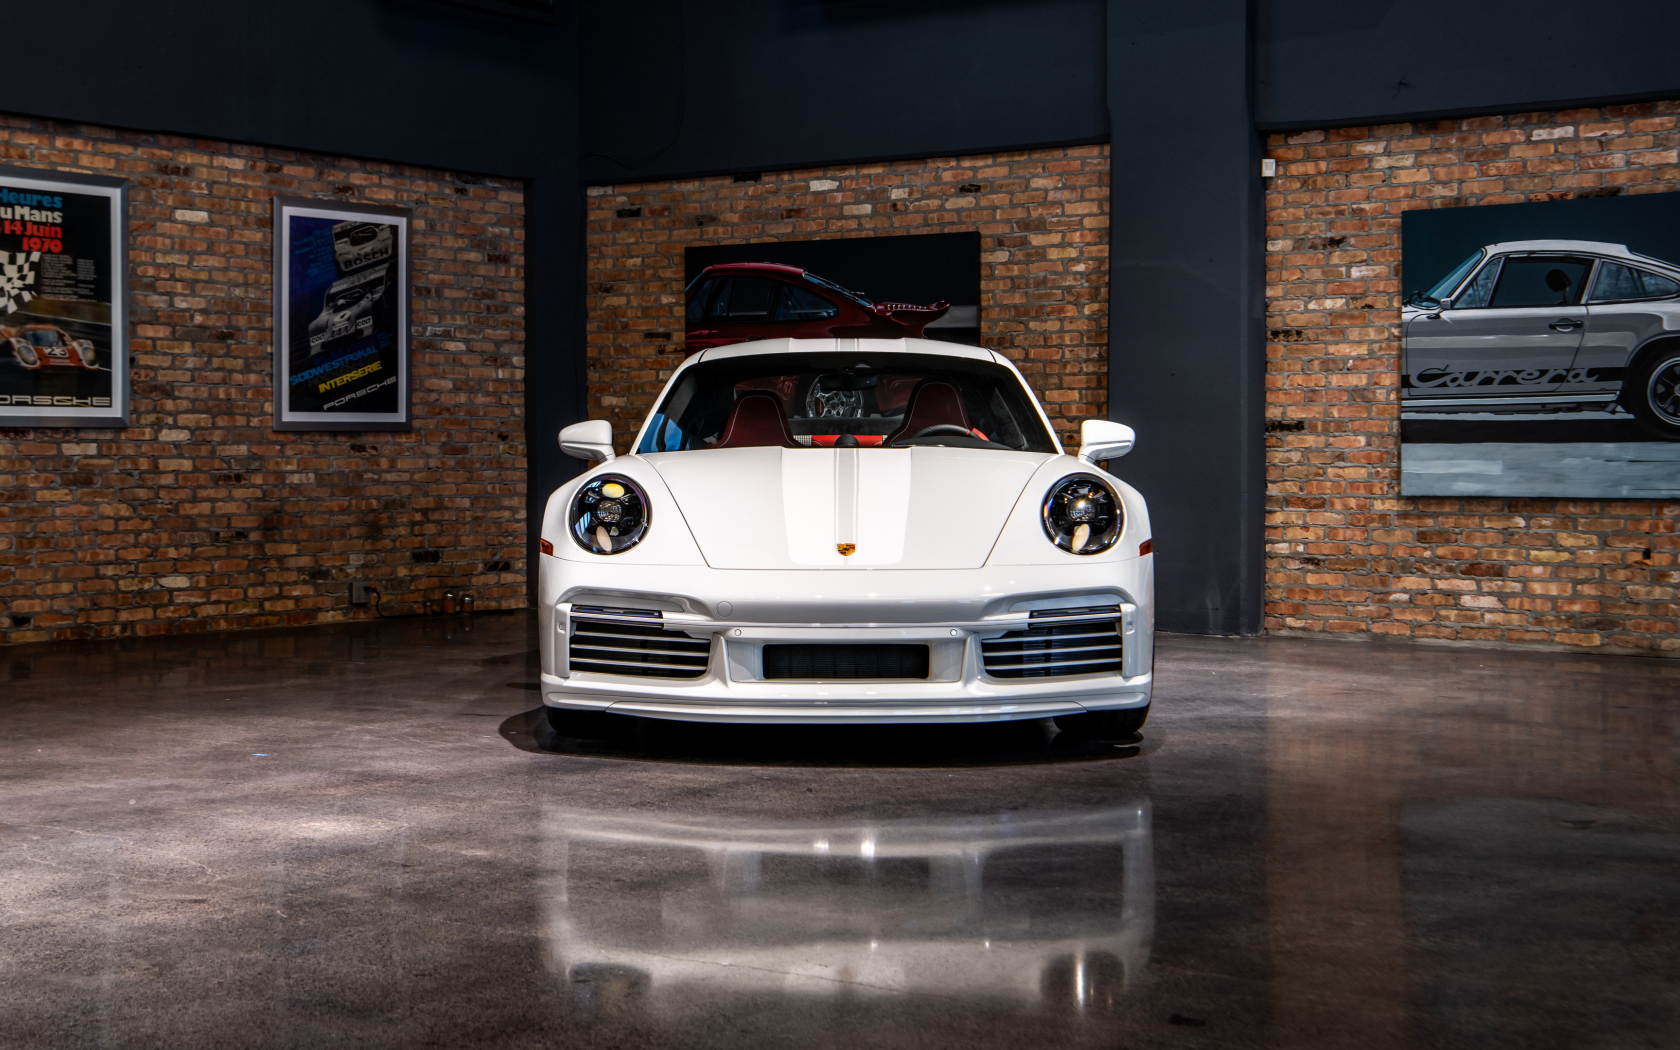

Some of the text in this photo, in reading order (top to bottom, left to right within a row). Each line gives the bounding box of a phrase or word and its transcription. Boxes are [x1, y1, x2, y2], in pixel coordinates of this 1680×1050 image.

[14, 205, 63, 224] Mans
[24, 221, 63, 239] Juin
[22, 236, 63, 254] 1970
[344, 248, 389, 270] BOSCH
[357, 317, 372, 328] COLT
[311, 333, 326, 344] COLT
[45, 346, 68, 357] 23
[318, 360, 383, 393] INTERSERIE
[1409, 364, 1600, 389] Carrera
[0, 394, 111, 406] ORSCHE
[323, 375, 397, 411] PORSCHE
